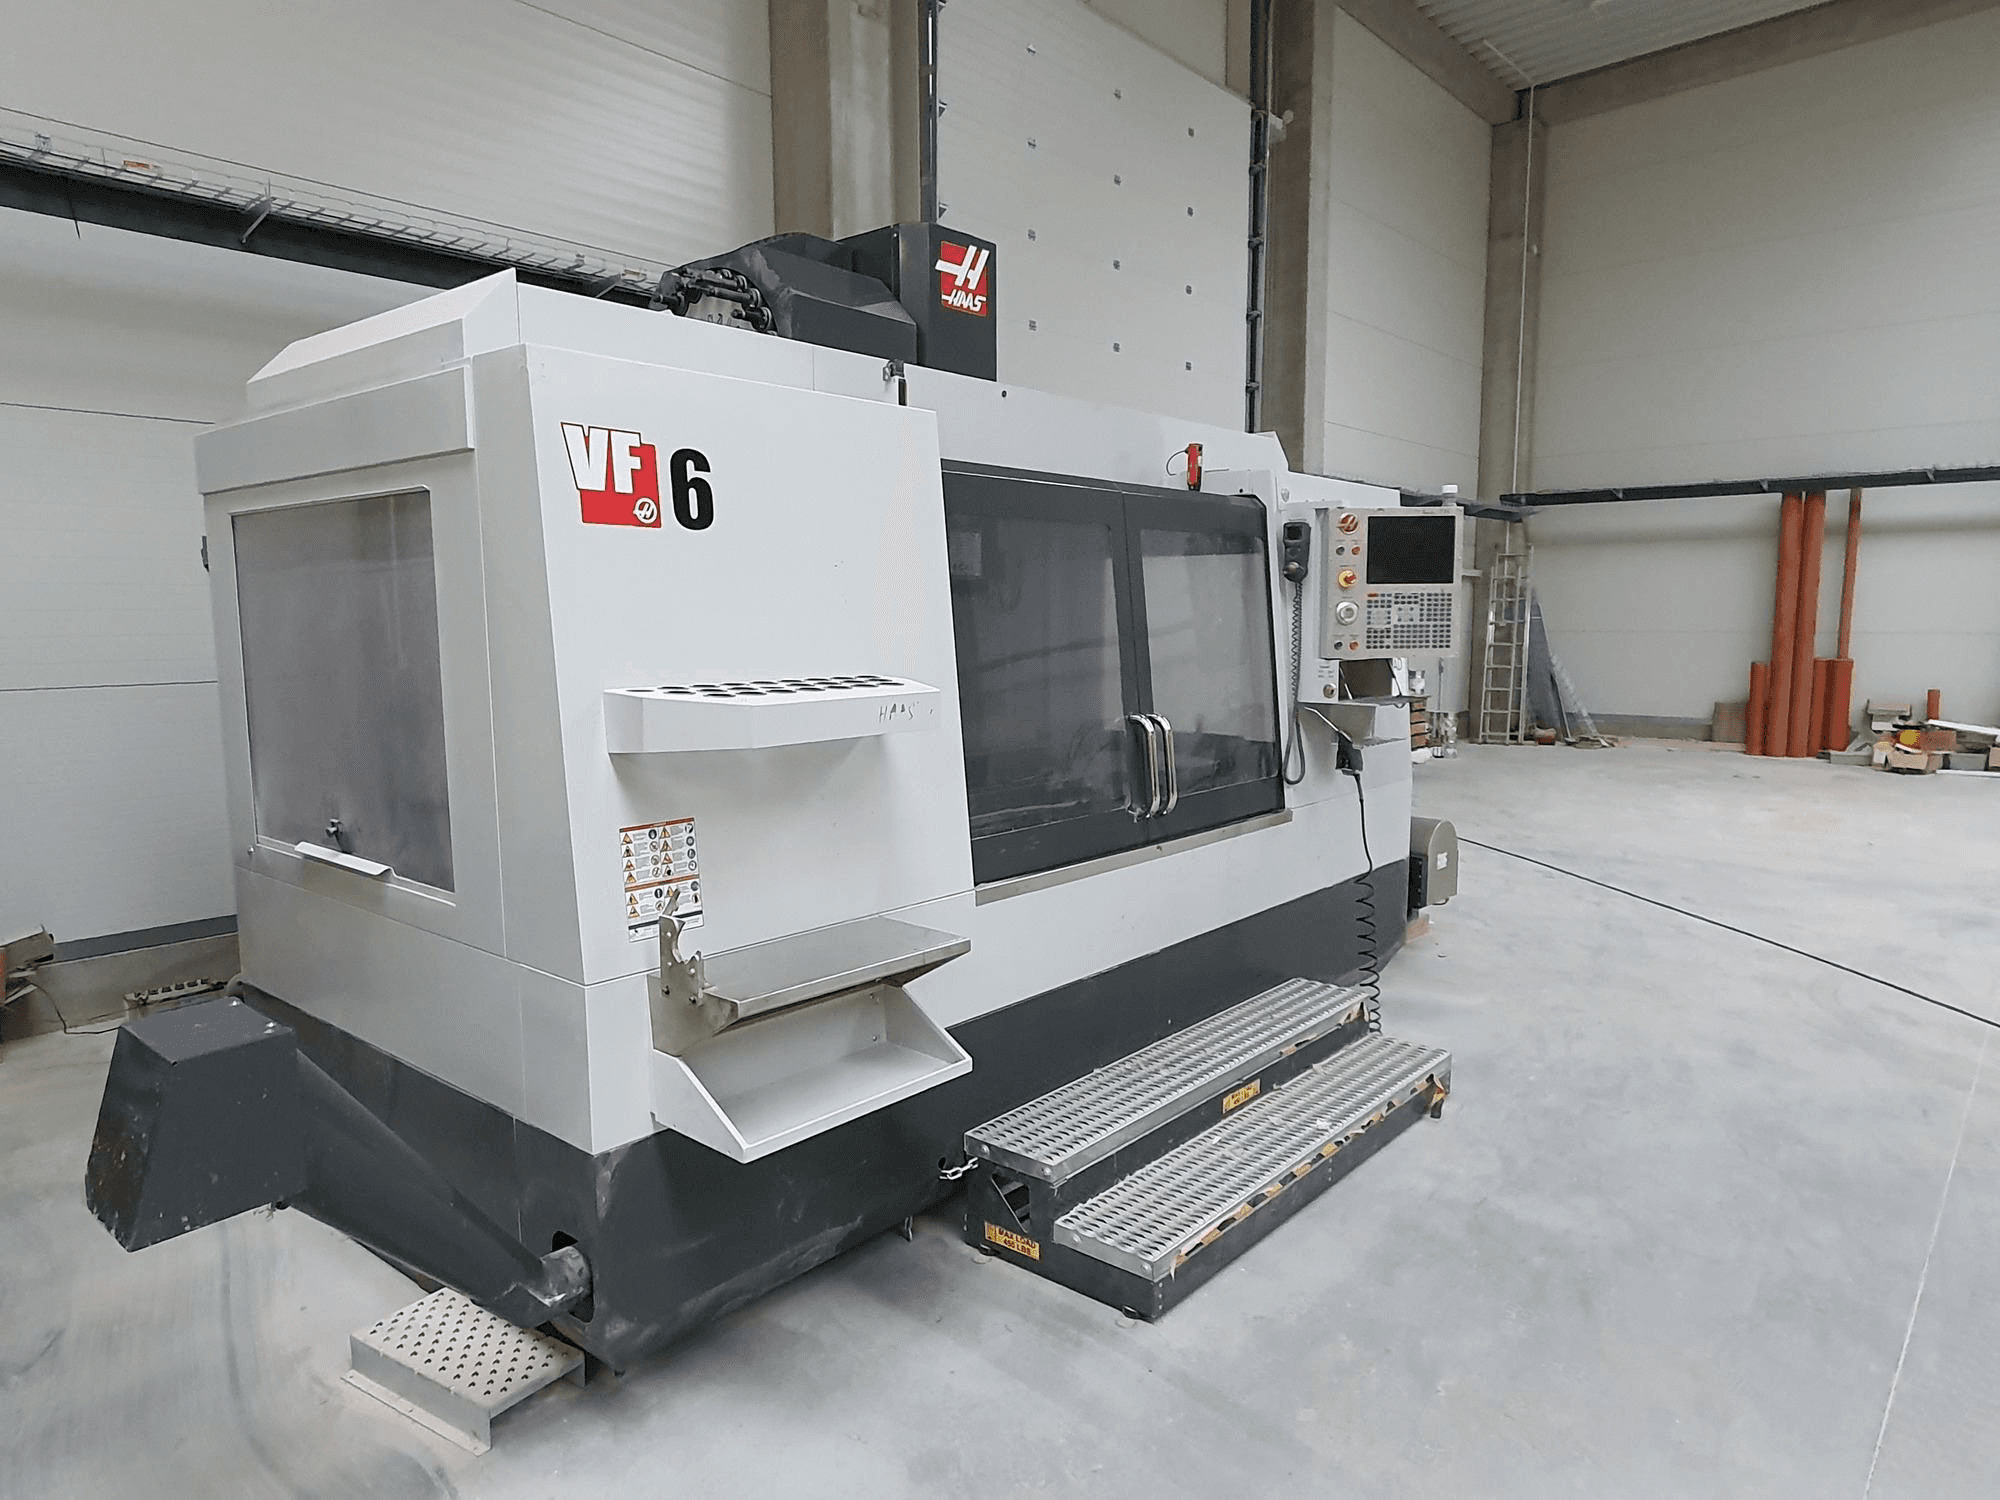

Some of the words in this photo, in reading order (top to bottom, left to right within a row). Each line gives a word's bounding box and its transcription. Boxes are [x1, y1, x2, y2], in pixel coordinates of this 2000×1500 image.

[941, 288, 987, 312] HAAS
[560, 421, 642, 495] VF
[669, 448, 715, 531] 6
